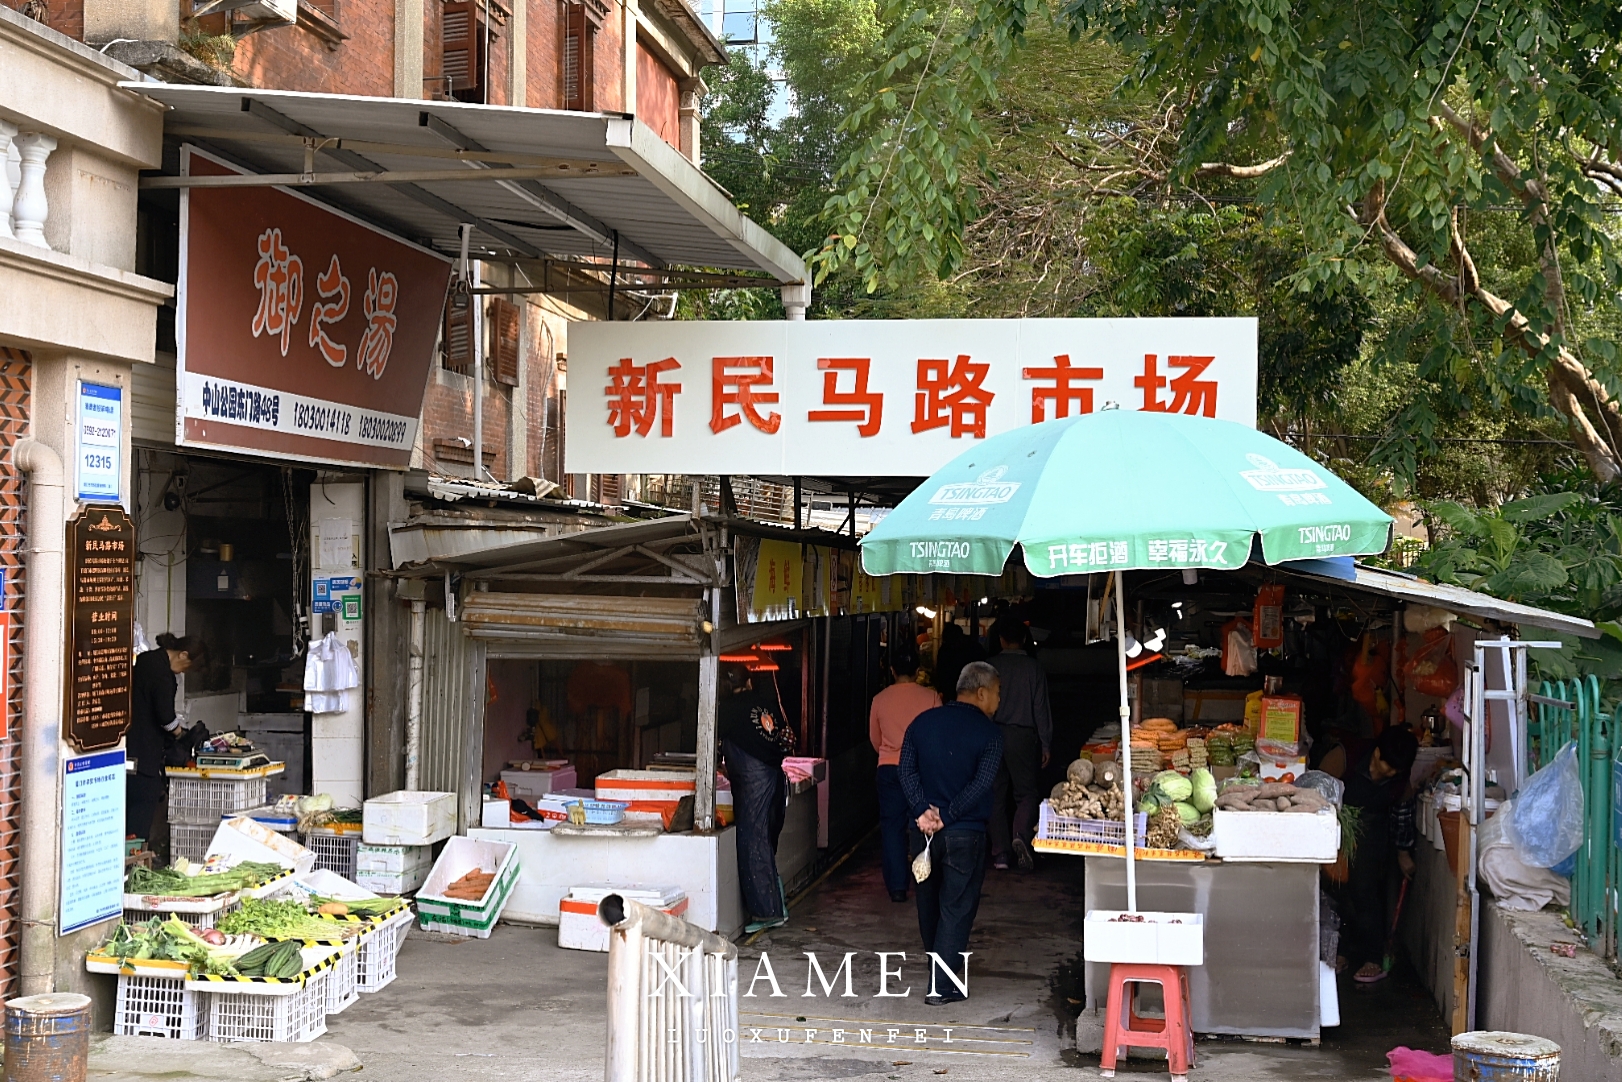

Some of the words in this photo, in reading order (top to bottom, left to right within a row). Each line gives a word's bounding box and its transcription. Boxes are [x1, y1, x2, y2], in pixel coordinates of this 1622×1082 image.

[202, 380, 280, 427] 中山公园东门路48号
[605, 354, 1218, 439] 新民马路市场
[84, 454, 112, 470] 12315
[1248, 473, 1318, 487] TSINGTAO
[939, 486, 1012, 500] TSINGTAO
[928, 507, 989, 521] 青岛啤酒
[1298, 524, 1351, 544] TSINGTAO
[84, 540, 125, 551] 新民马路市场
[909, 541, 970, 559] TSINGTAO
[1047, 540, 1129, 569] 开车拒酒
[1148, 538, 1228, 565] 幸福永久
